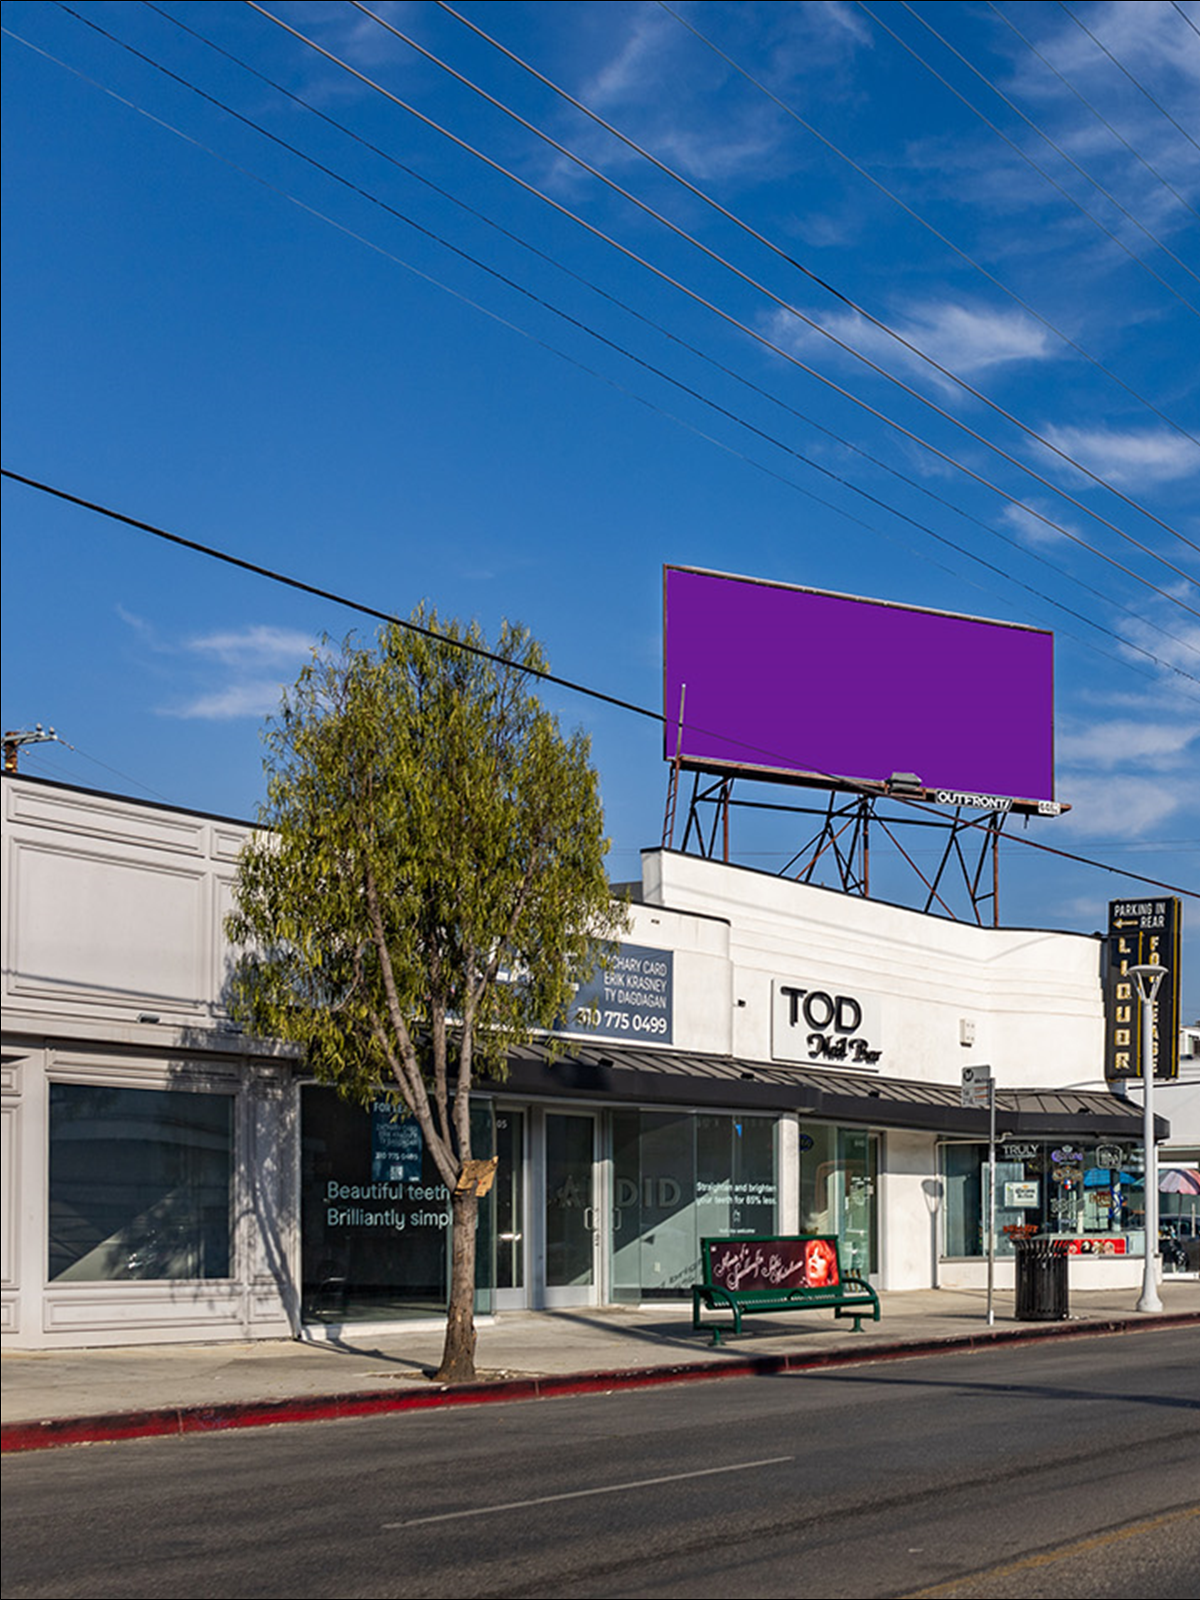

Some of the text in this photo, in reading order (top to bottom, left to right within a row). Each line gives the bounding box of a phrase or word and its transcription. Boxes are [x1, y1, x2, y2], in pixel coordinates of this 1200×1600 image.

[1114, 902, 1166, 917] PARKING IN
[1140, 915, 1165, 928] REAR
[642, 960, 667, 976] CARD
[604, 971, 668, 993] ERIK KRASNEY
[604, 987, 667, 1008] TY DAGDAGAN
[1114, 936, 1132, 1070] LIQUOR
[780, 985, 863, 1036] TOD
[604, 1010, 629, 1030] 775
[632, 1014, 667, 1034] 0499
[848, 1038, 883, 1065] Bar
[1002, 1143, 1039, 1155] TRULY
[327, 1180, 450, 1200] Beautiful teeth
[734, 1183, 748, 1193] and
[327, 1207, 405, 1230] Brilliantly
